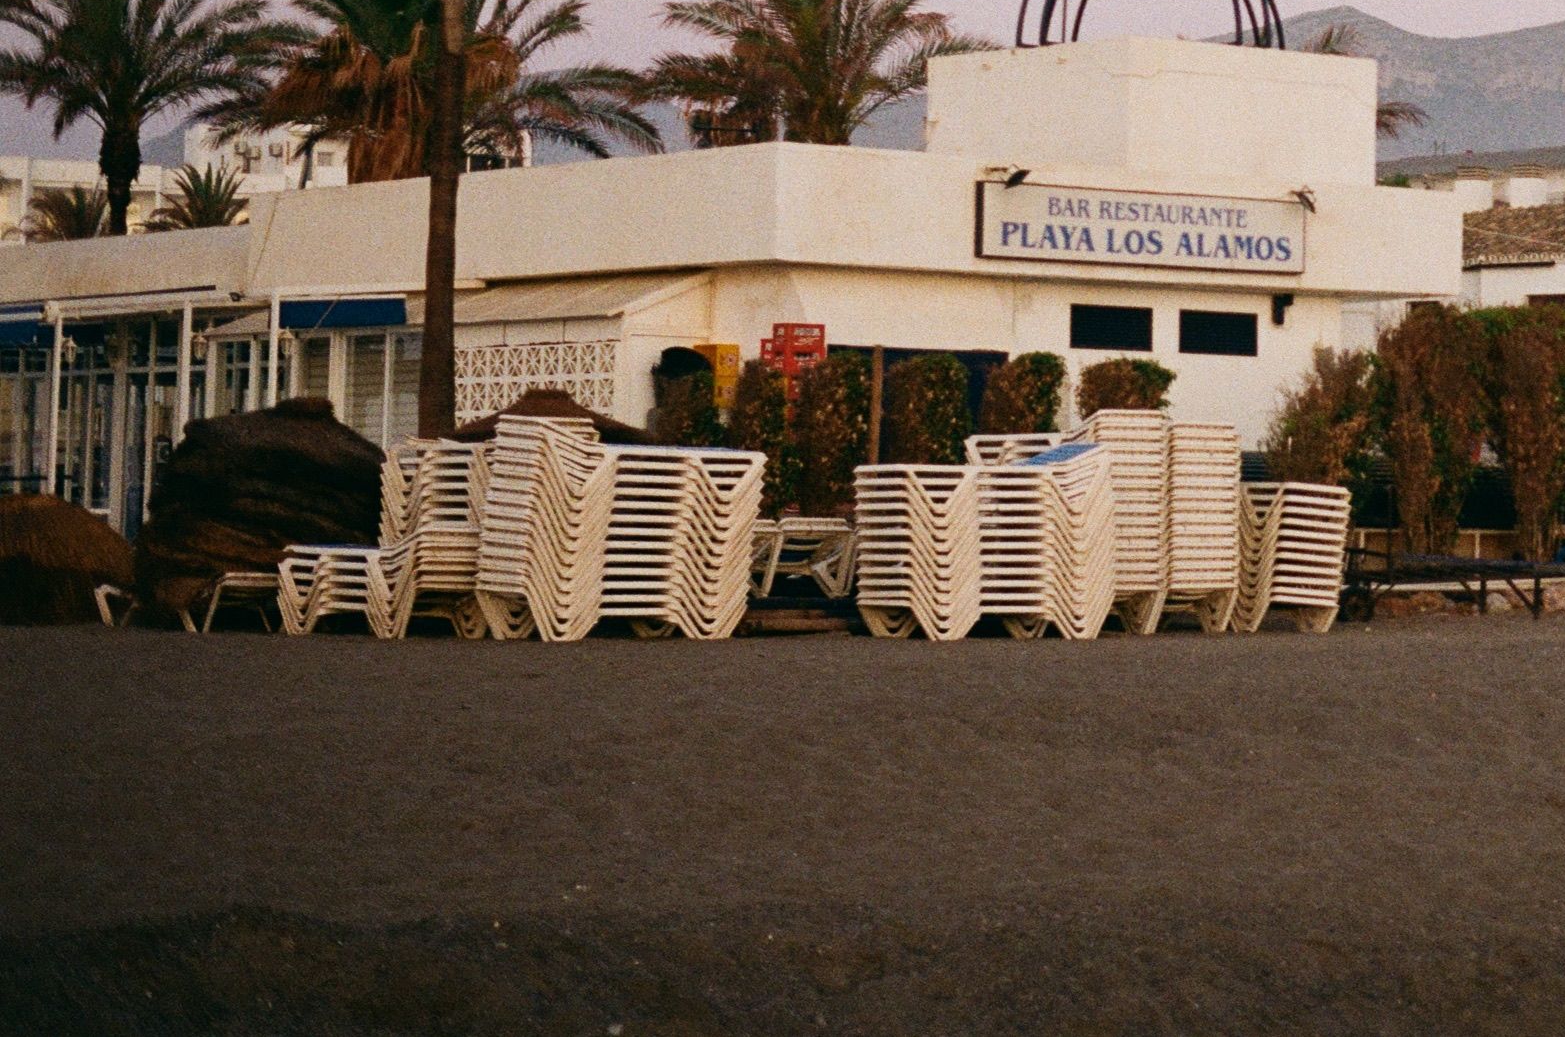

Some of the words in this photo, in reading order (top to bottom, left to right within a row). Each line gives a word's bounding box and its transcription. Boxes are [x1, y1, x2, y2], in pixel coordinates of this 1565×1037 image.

[1048, 196, 1090, 218] BAR
[1099, 200, 1249, 229] RESTAURANTE
[1000, 221, 1095, 252] PLAYA
[1106, 227, 1163, 255] LOS
[1175, 231, 1292, 261] ALAMOS
